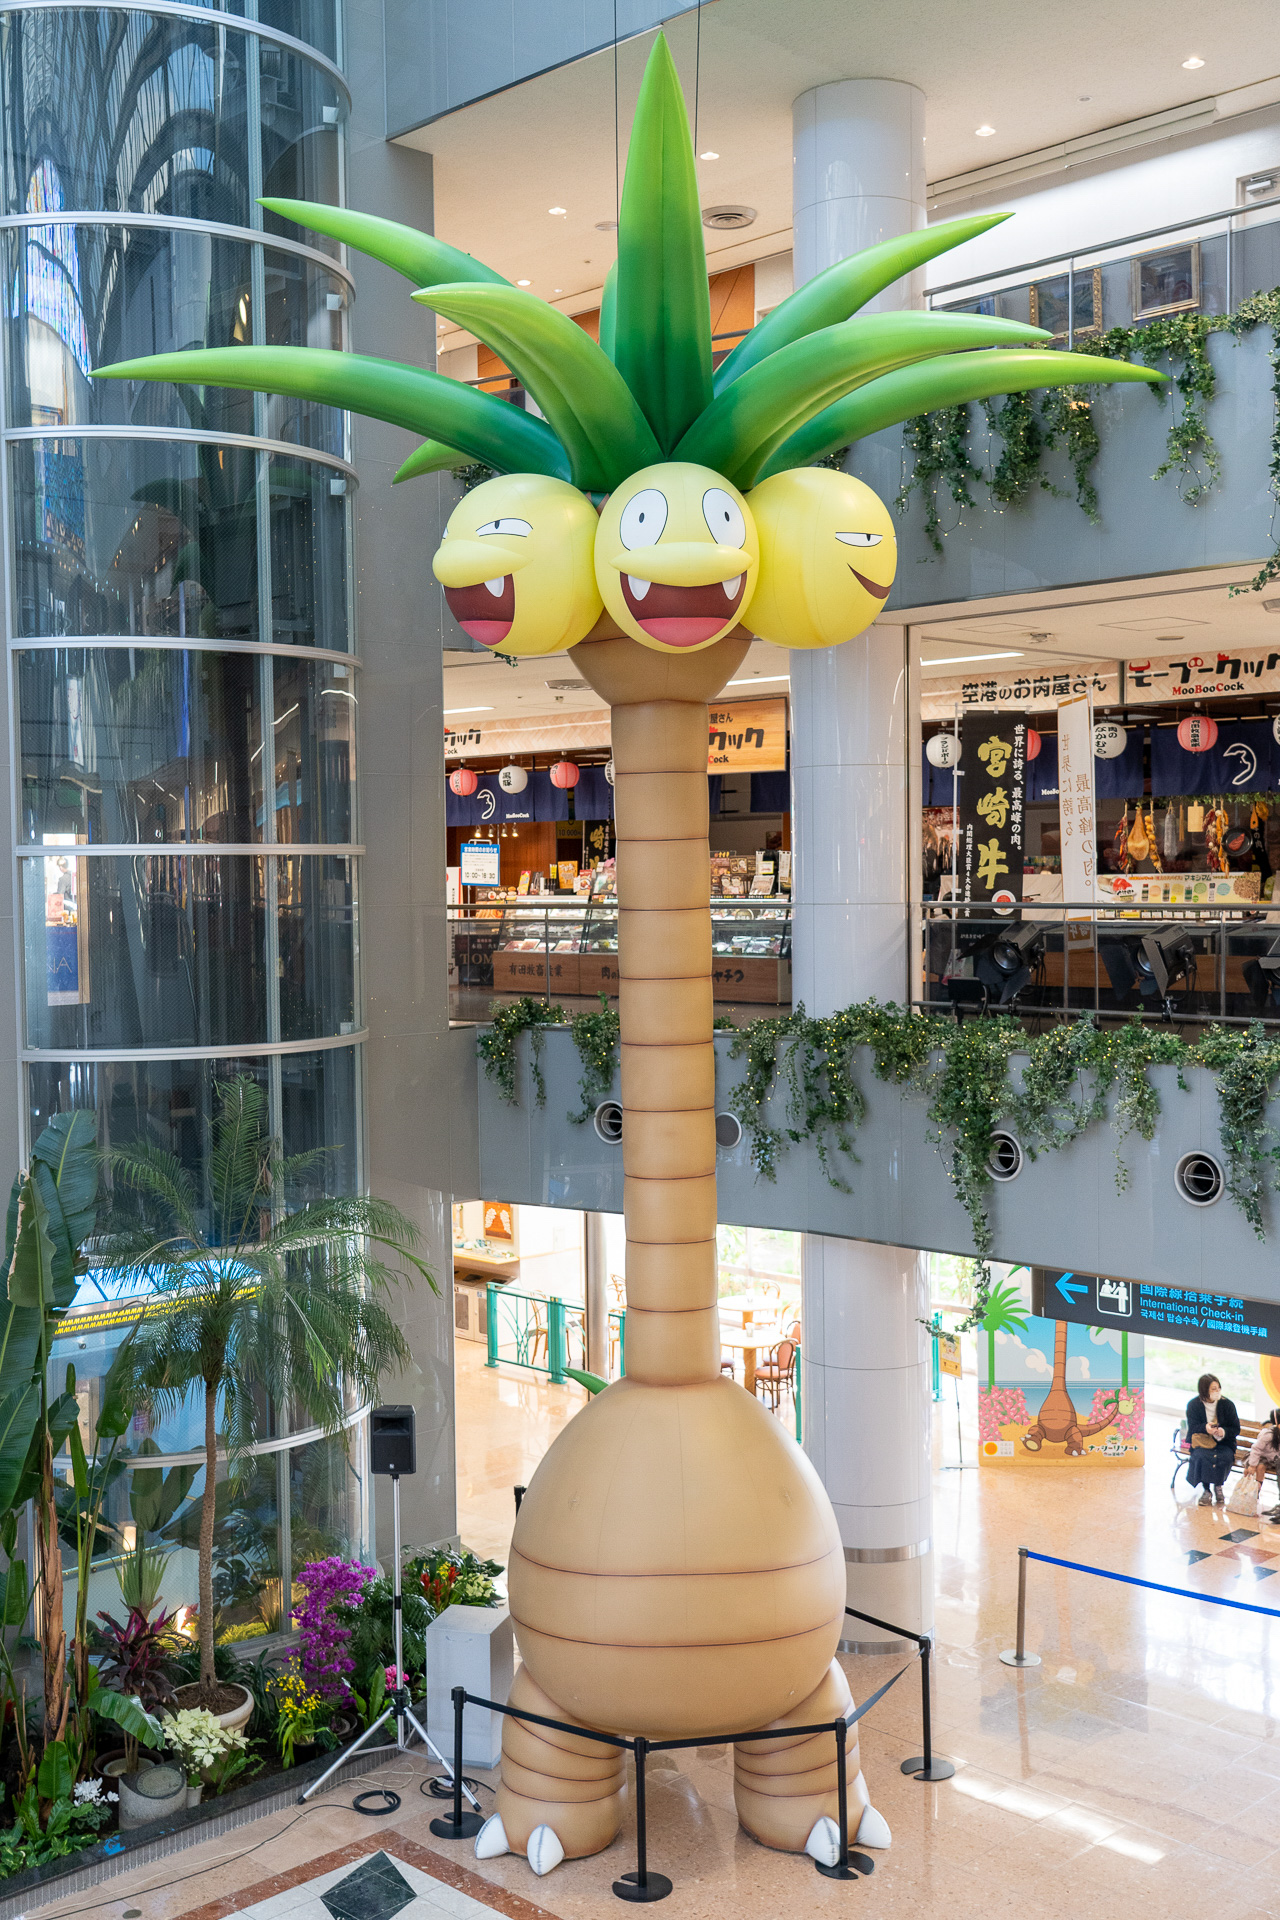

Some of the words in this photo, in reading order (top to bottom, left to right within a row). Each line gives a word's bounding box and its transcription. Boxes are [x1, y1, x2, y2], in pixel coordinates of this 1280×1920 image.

[962, 673, 1107, 704] 空港のお肉屋さん
[1172, 681, 1244, 696] MooBooCock
[1010, 724, 1026, 850] 世界に誇る、最高峰の肉。
[976, 735, 1012, 890] 宮崎牛
[1140, 1297, 1199, 1315] International
[1200, 1306, 1244, 1322] Check-in
[1140, 1308, 1165, 1321] 국제선
